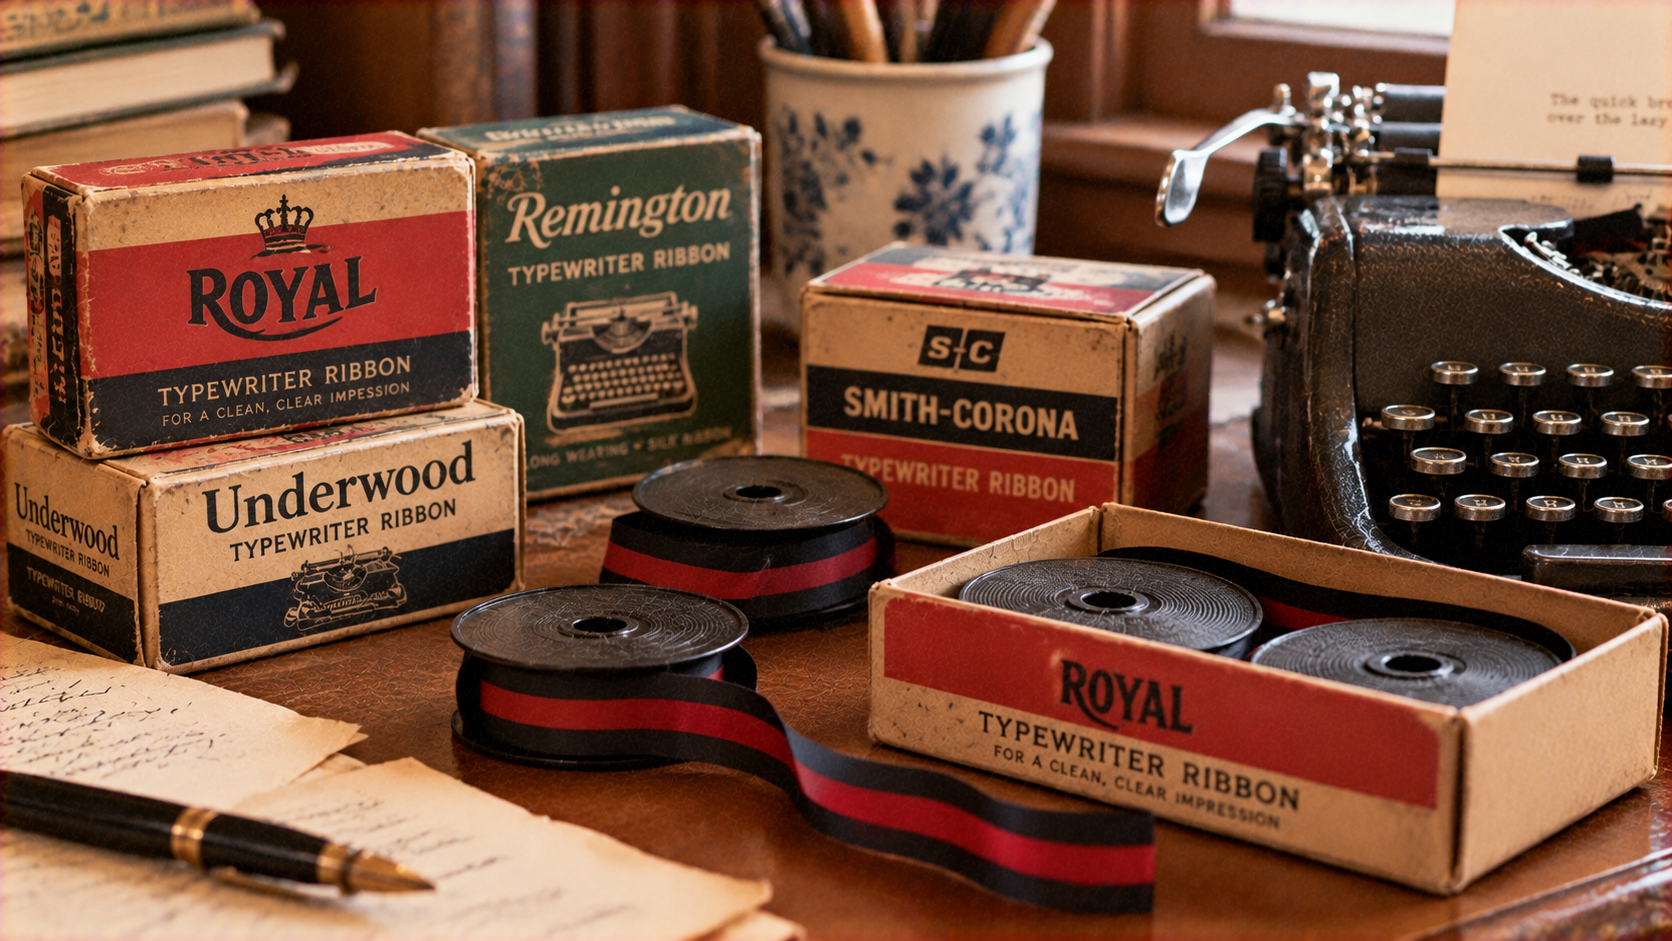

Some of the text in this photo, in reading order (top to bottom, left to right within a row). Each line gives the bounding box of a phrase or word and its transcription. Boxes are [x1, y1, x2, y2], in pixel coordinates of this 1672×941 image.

[1547, 112, 1668, 129] over the lazy
[1550, 93, 1578, 107] The
[1589, 95, 1637, 110] quick
[505, 184, 732, 249] Remington
[507, 242, 731, 286] TYPEWRITER RIBBON
[186, 256, 378, 341] ROYAL
[157, 355, 411, 407] TYPEWRITER RIBBON
[162, 381, 411, 427] FOR A CLEAN, CLEAR IMPESSION
[844, 386, 1079, 441] SMITH-CORONA
[526, 452, 560, 470] ONG
[565, 442, 629, 464] WEARING
[841, 453, 1075, 503] TYPEWRITER RIBBON
[201, 439, 477, 534] Underwood
[14, 482, 120, 560] Underwood
[229, 498, 456, 562] TYPEWRITER RIBBON
[25, 528, 110, 578] TYPEWRITER RIBBON
[1059, 658, 1194, 734] ROYAL
[978, 711, 1299, 811] TYPEWRITER RIBBON
[993, 745, 1281, 829] FOR A CLEAN, CLEAR IMPRESSION
